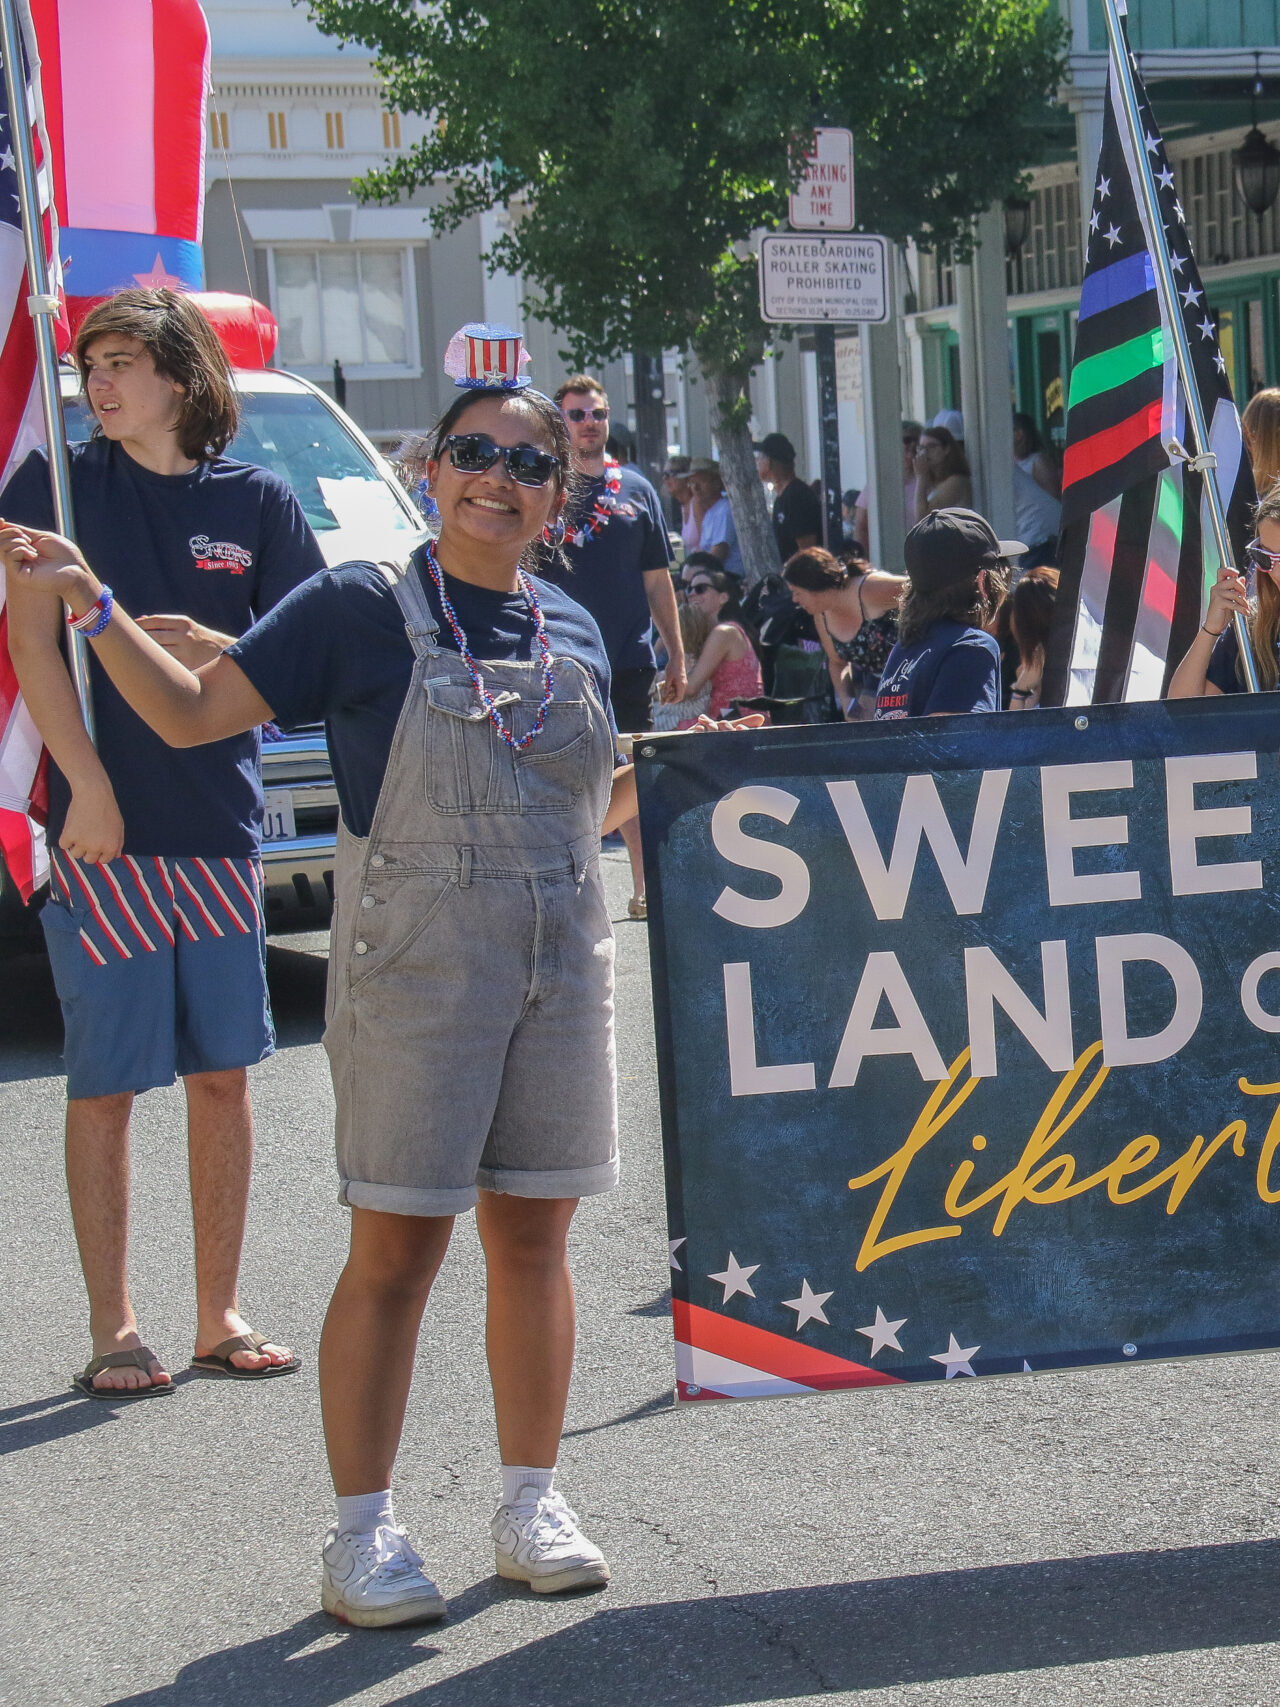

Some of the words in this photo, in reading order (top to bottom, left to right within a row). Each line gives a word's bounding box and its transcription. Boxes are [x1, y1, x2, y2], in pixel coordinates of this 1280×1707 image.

[803, 164, 847, 183] ARKING
[811, 185, 832, 199] ANY
[810, 202, 832, 216] TIME
[771, 244, 875, 258] SKATEBOARDING
[770, 261, 819, 274] ROLLER
[824, 262, 877, 275] SKATING
[787, 277, 862, 290] PROHIBITED
[770, 296, 785, 305] CITY
[787, 296, 795, 305] OF
[824, 297, 859, 305] MUNICIPAL
[207, 561, 225, 570] Since
[722, 932, 1204, 1097] LAND
